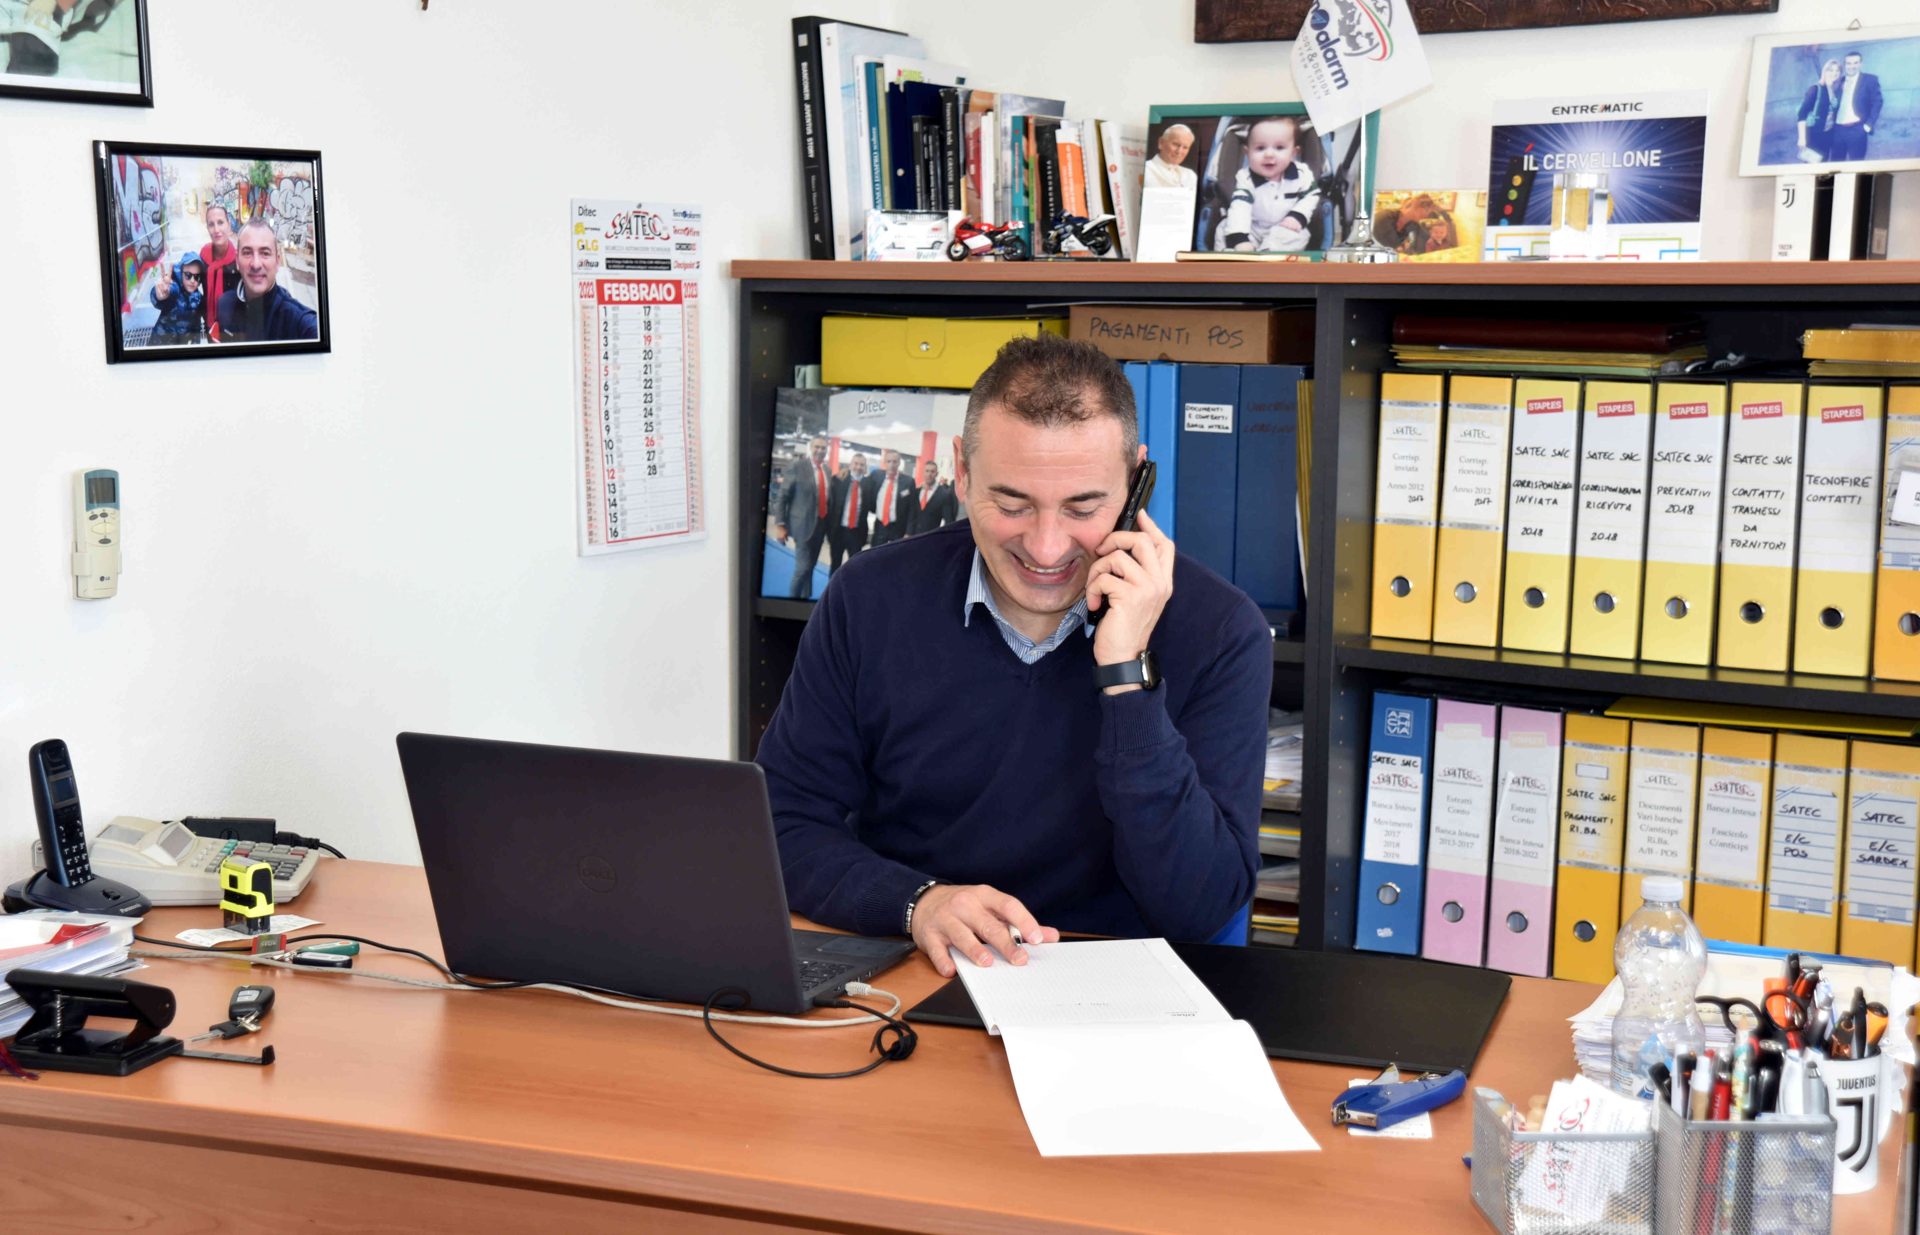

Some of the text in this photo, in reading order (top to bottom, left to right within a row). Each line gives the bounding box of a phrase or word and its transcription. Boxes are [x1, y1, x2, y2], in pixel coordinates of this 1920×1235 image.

[801, 61, 815, 158] BIANCONERI JUVENTUS STORY
[1551, 102, 1643, 116] ENTREMATIC
[1543, 149, 1662, 171] CERVELLONE
[577, 205, 597, 217] Ditec
[603, 283, 676, 301] FEBBRAIO
[603, 306, 651, 317] 1 17
[603, 321, 652, 332] 2 18
[1090, 317, 1244, 349] PAGAMENTI POS
[603, 335, 652, 347] 3 19
[603, 350, 653, 361] 4 20
[603, 365, 652, 377] 5 21
[603, 379, 653, 392] 6 22
[604, 393, 653, 406] 7 23
[857, 396, 887, 414] Ditec
[1528, 400, 1562, 412] STAPLES
[1598, 403, 1634, 415] STAPLES
[1671, 405, 1707, 417] STAPLES
[1743, 405, 1781, 416] STAPLES
[604, 407, 653, 421] 8 24
[1822, 408, 1862, 421] STAPLES
[604, 422, 654, 436] 9 25
[604, 437, 655, 450] 10 26
[605, 451, 656, 465] 11 27
[1515, 446, 1570, 459] SATEC SNC
[1585, 451, 1641, 462] SATEC SNC
[1654, 452, 1713, 464] SATEC SNC
[1733, 454, 1793, 465] SATEC SNC
[606, 465, 657, 480] 12 28
[1394, 463, 1419, 473] inviata
[1458, 467, 1488, 477] ricevuta
[1387, 481, 1425, 491] Anno 2012
[1806, 474, 1872, 488] TECNOFIRE
[607, 484, 617, 494] 13
[1453, 485, 1492, 495] Anno 2012
[1657, 486, 1711, 497] PREVENTIVI
[1732, 487, 1785, 500] CONTATTI
[608, 498, 618, 508] 14
[1515, 495, 1558, 506] INVIATA
[1806, 494, 1862, 505] CONTATTI
[1585, 501, 1632, 511] RICEVUTA
[1665, 504, 1694, 515] 2018
[609, 513, 618, 524] 15
[609, 528, 619, 539] 16
[1521, 526, 1543, 537] 2018
[1743, 524, 1757, 532] DA
[1591, 532, 1618, 541] 2018
[1730, 538, 1786, 550] FORNITORI
[1372, 755, 1397, 767] SATEC
[1446, 795, 1472, 805] Estratti
[1566, 788, 1595, 800] SATEC
[1372, 801, 1393, 810] Banca
[1447, 806, 1470, 816] Conto
[1510, 803, 1536, 814] Estratti
[1638, 801, 1682, 813] Documenti
[1706, 803, 1756, 817] Banca Intesa
[1779, 804, 1822, 818] SATEC
[1373, 817, 1413, 829] Movimenti
[1512, 816, 1534, 824] Conto
[1564, 811, 1614, 824] PAGAMENTI
[1637, 812, 1683, 824] Vari banche
[1861, 811, 1906, 825] SATEC
[1435, 826, 1480, 838] Banca Intesa
[1712, 827, 1748, 839] Fascicolo
[1500, 835, 1544, 848] Banca Intesa
[1785, 833, 1811, 845] E/C
[1709, 839, 1749, 852] C/anticipi
[1869, 840, 1899, 852] E/C
[1660, 848, 1678, 857] POS
[1783, 847, 1808, 858] POS
[1857, 853, 1908, 868] SARDEX
[1836, 1073, 1876, 1090] JUVENTUS
